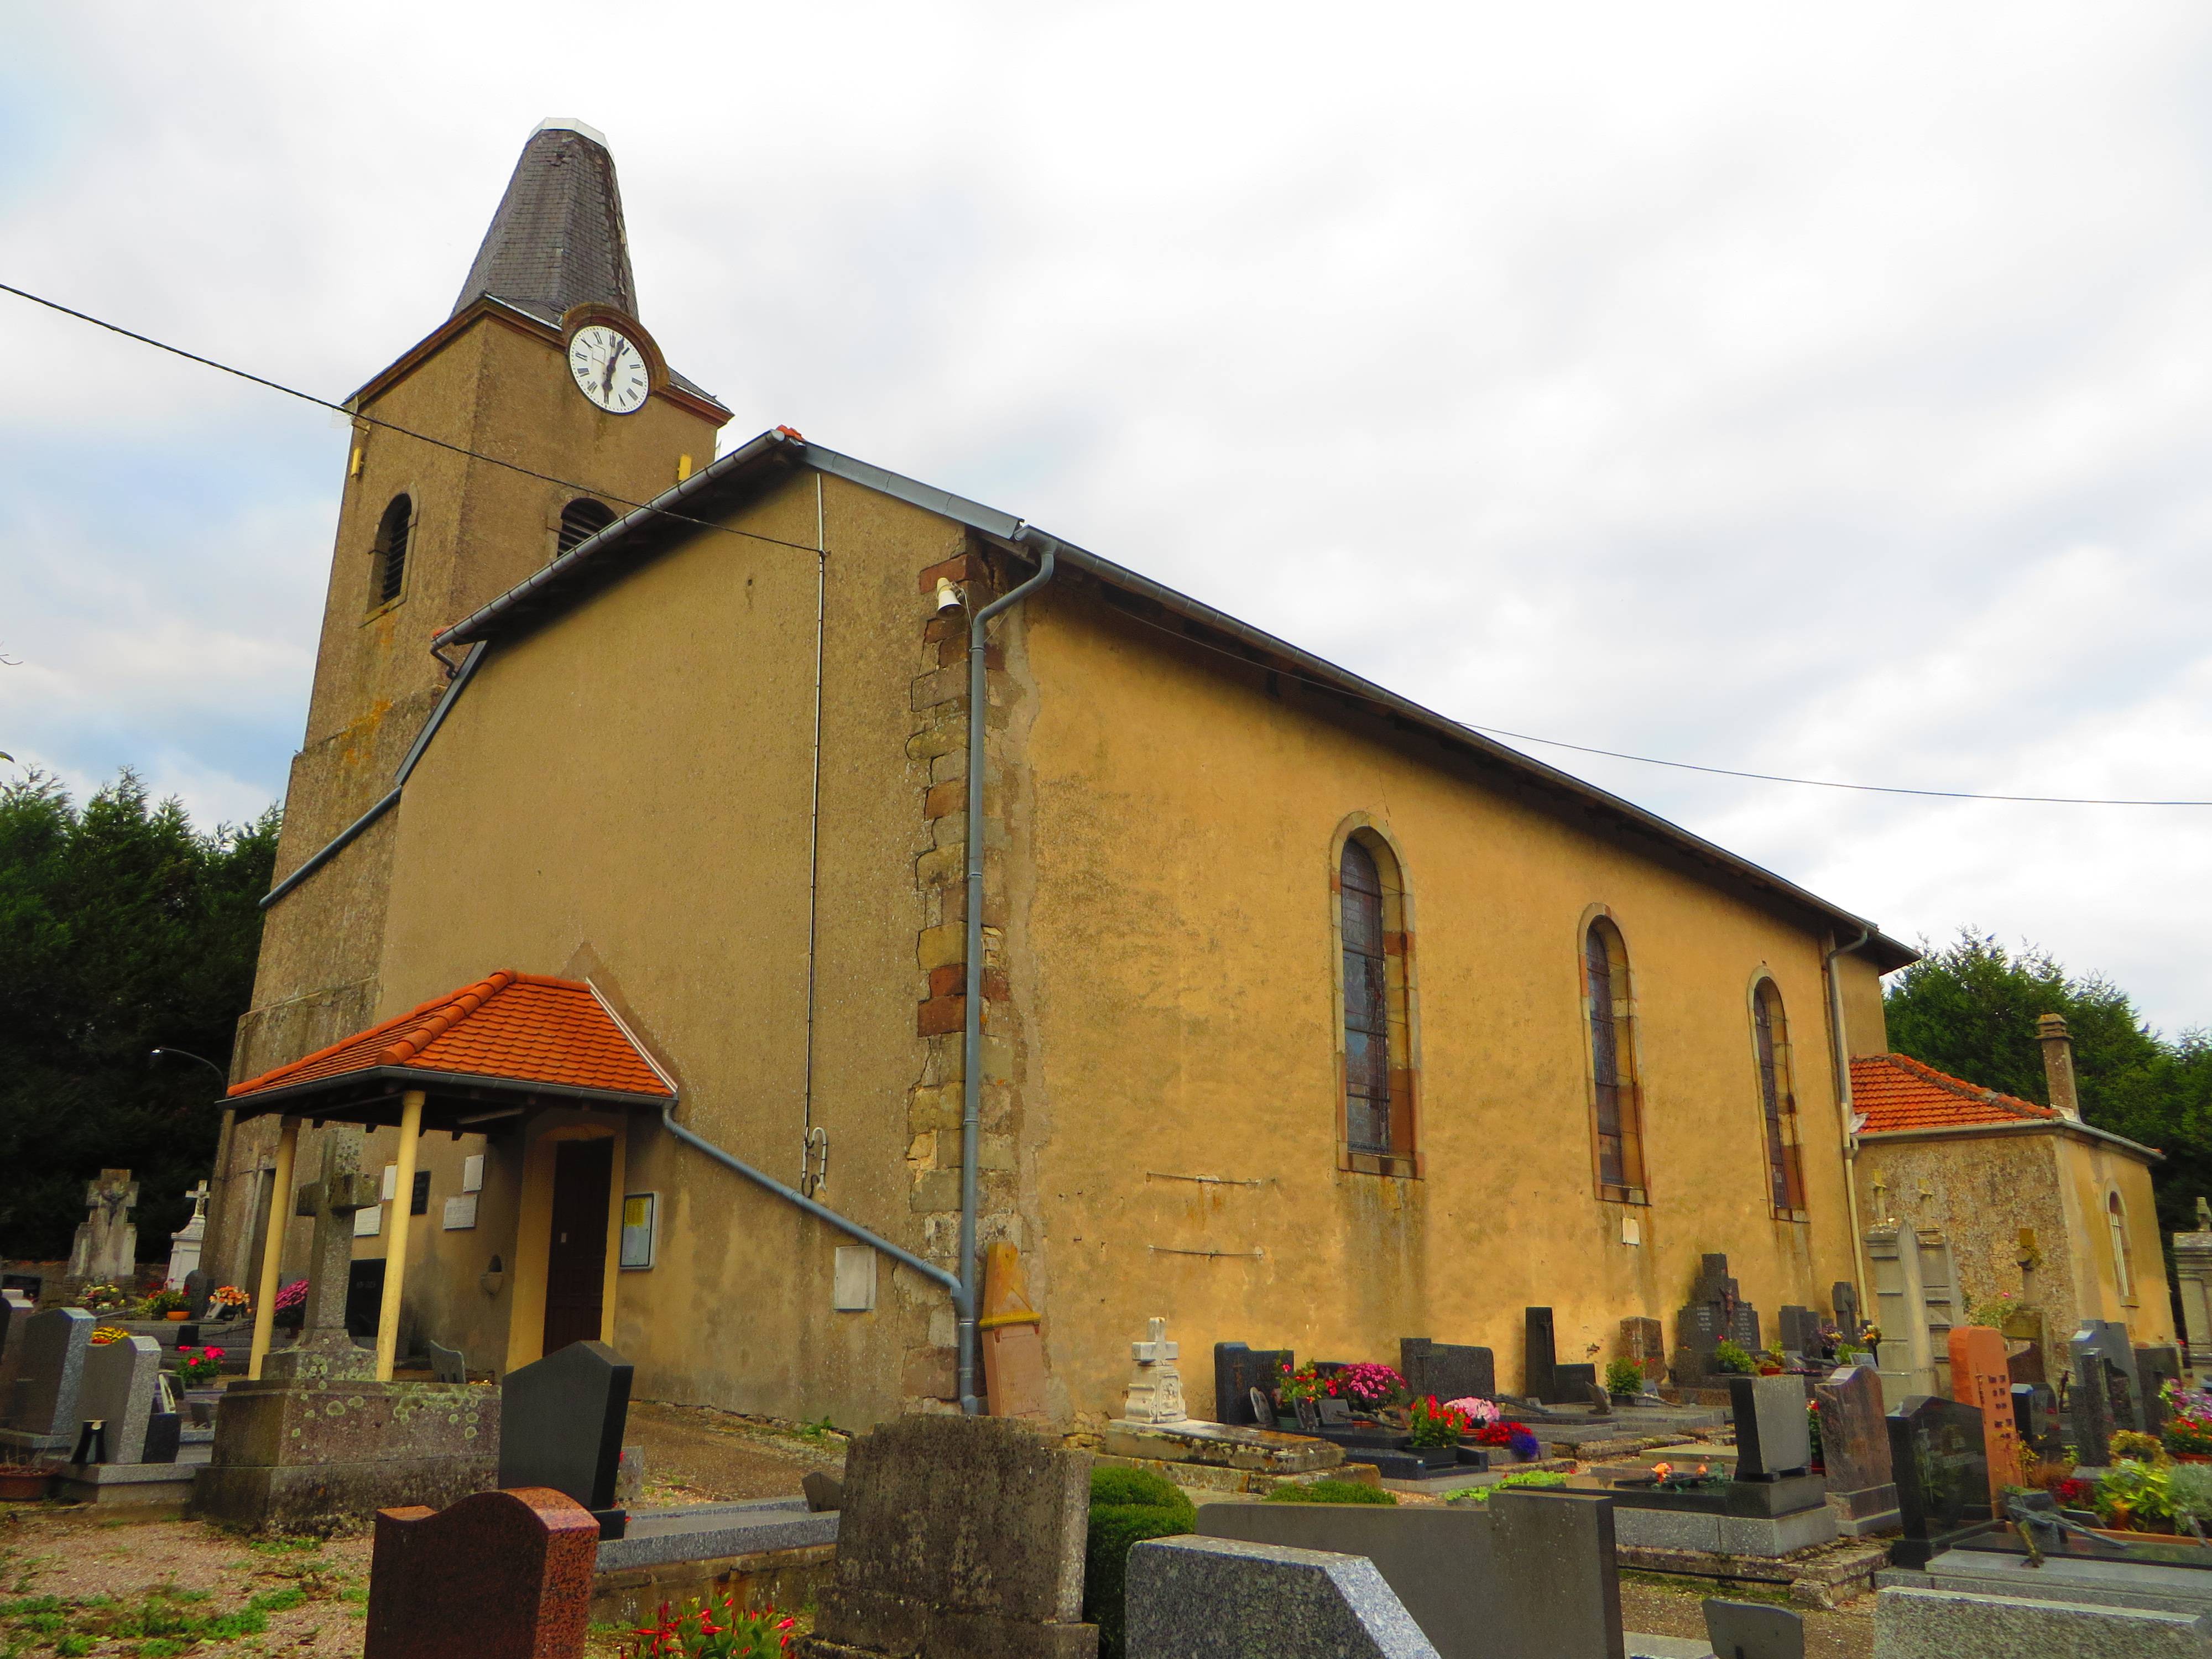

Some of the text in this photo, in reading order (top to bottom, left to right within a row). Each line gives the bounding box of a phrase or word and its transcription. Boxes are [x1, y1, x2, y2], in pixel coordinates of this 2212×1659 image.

[581, 337, 593, 350] X
[593, 332, 603, 345] XI
[622, 347, 630, 356] I
[632, 377, 644, 387] III
[618, 393, 626, 407] V
